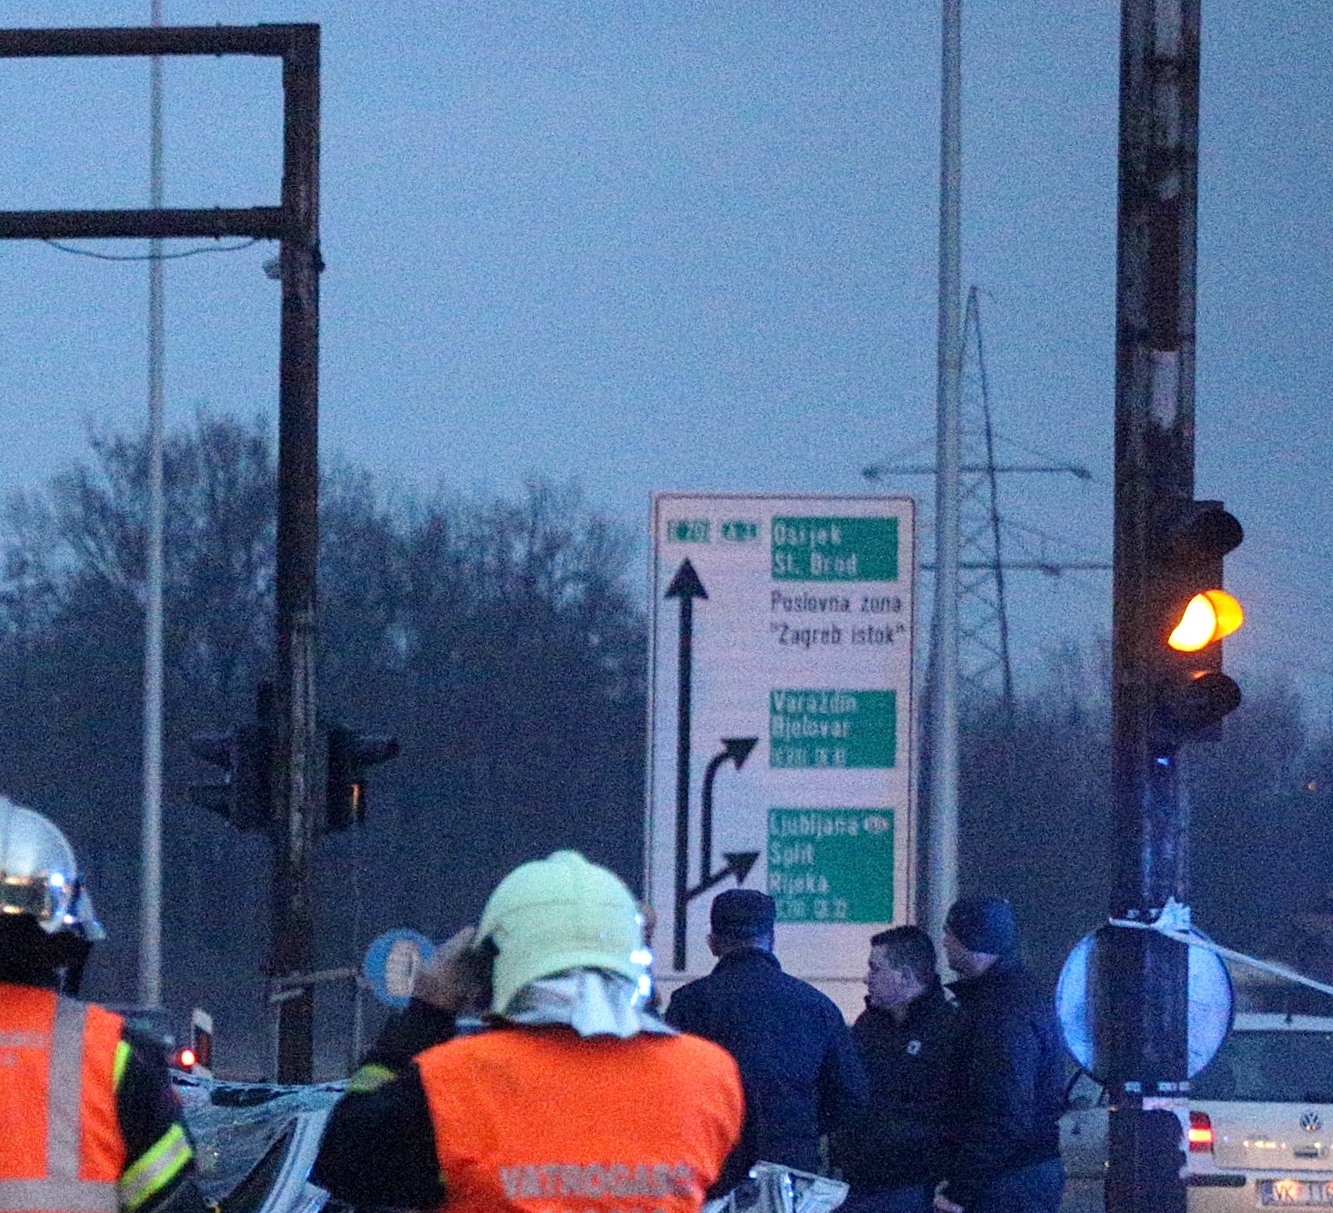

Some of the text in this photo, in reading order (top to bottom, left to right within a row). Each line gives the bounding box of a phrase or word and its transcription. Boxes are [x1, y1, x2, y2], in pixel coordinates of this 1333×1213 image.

[774, 524, 841, 548] Osijek
[811, 552, 858, 574] Brod
[771, 590, 902, 612] Poslovna zona
[770, 842, 815, 868] Split
[768, 872, 830, 898] Rijeka
